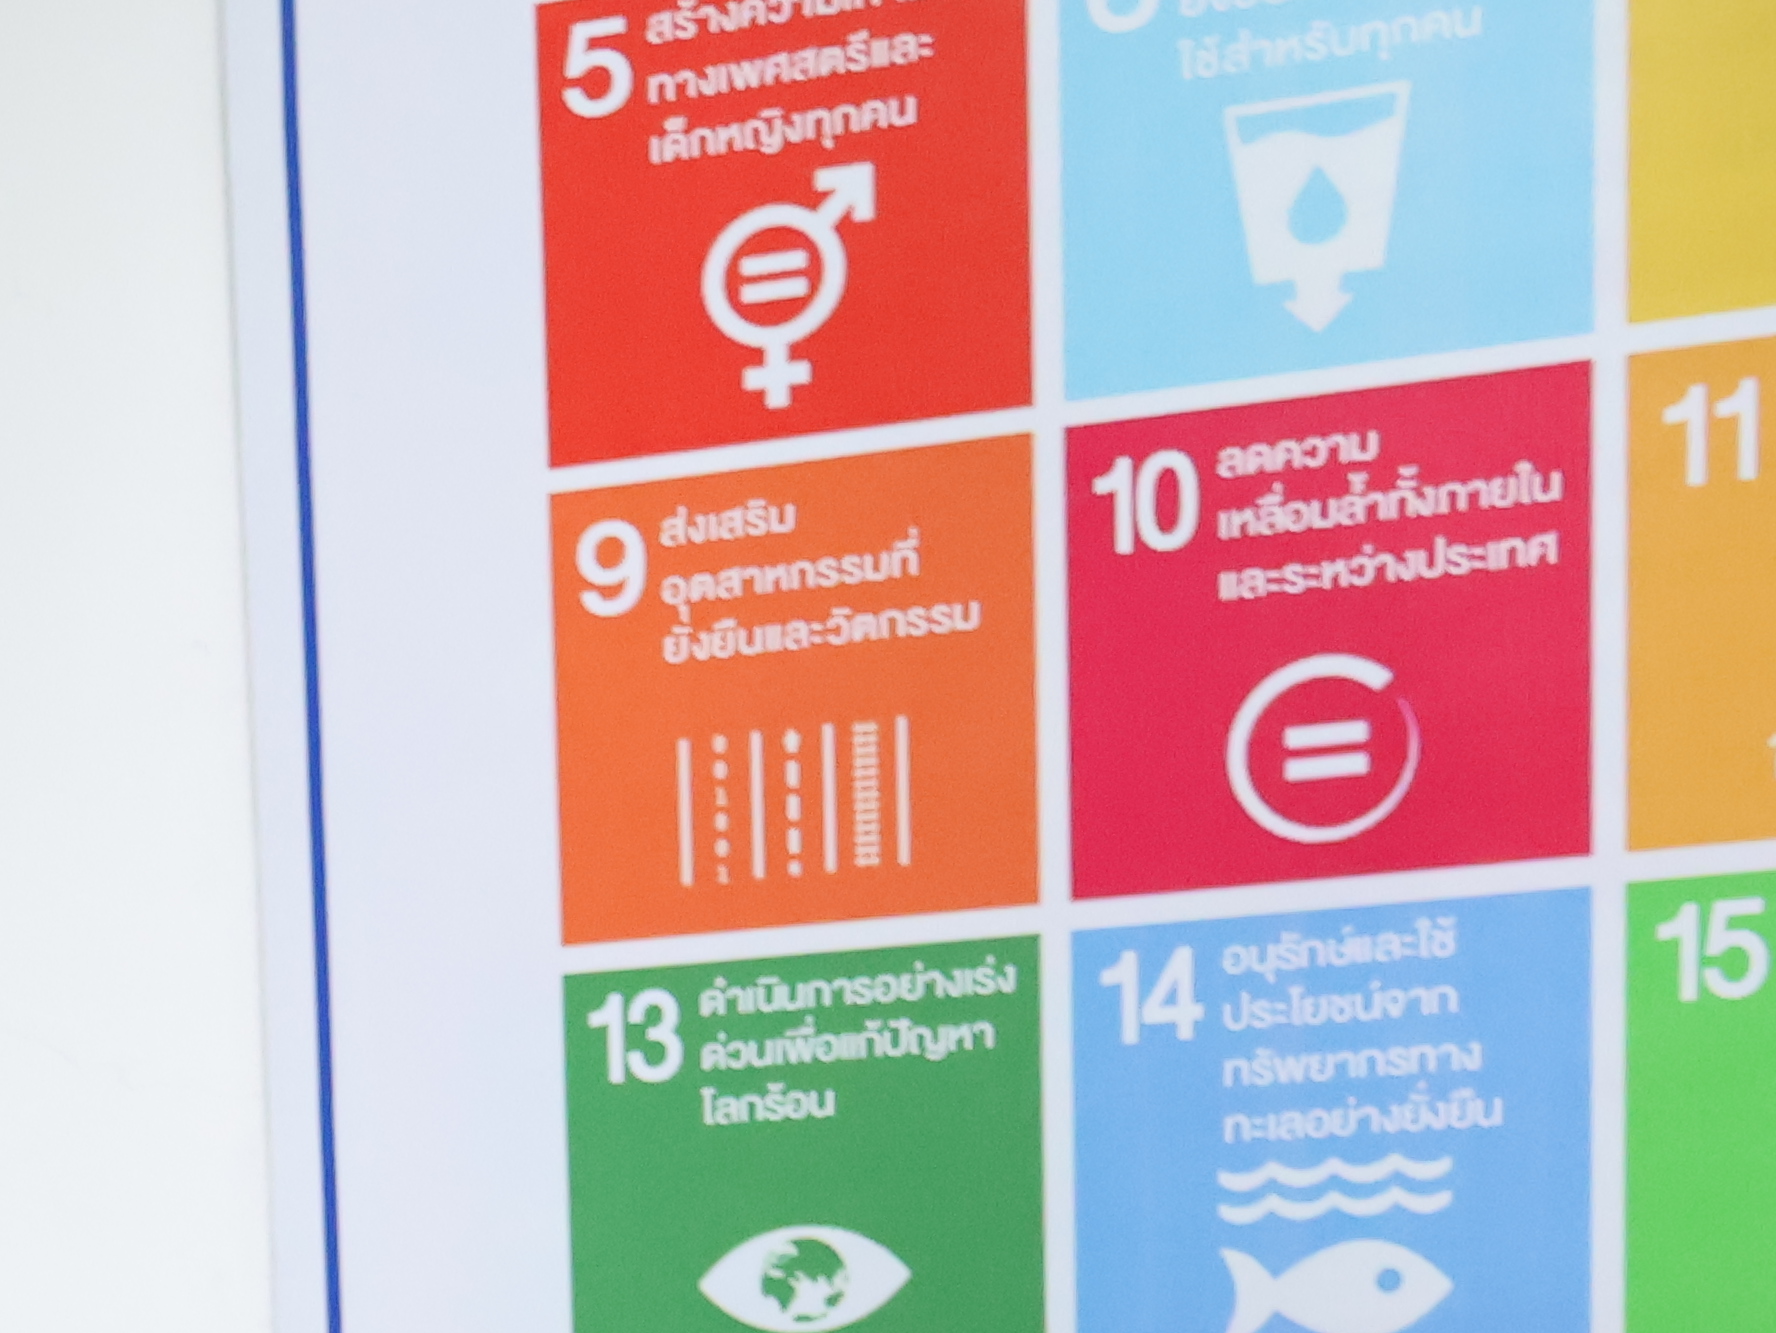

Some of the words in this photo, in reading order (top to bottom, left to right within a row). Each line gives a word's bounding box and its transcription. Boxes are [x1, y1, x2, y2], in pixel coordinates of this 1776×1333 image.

[561, 15, 634, 118] 5
[647, 94, 920, 165] เด็กหญิงทุกคน
[1216, 429, 1380, 479] ลดความ
[1662, 376, 1759, 487] 11
[659, 499, 797, 547] ส่งเสริม
[1092, 448, 1200, 555] 10
[575, 518, 647, 617] 9
[660, 527, 920, 622] อุตสาหกรรมที่
[1217, 530, 1560, 602] และระหว่างประเทศ
[1221, 916, 1457, 983] อนุรักษ์และใช้
[1655, 897, 1770, 1001] 15
[698, 955, 1018, 1017] ดำเนินการอย่างเร่ง
[1099, 945, 1204, 1045] 14
[1222, 981, 1459, 1031] ประโยชน์จาก
[586, 988, 684, 1085] 13
[699, 1016, 997, 1071] ด่วนเพื่อแก้ปัญหา
[1222, 1042, 1483, 1087] ทรัพยากรทาง
[699, 1082, 835, 1126] โลกร้อน
[1223, 1080, 1503, 1144] ทะเลอย่างยั่งยืน
